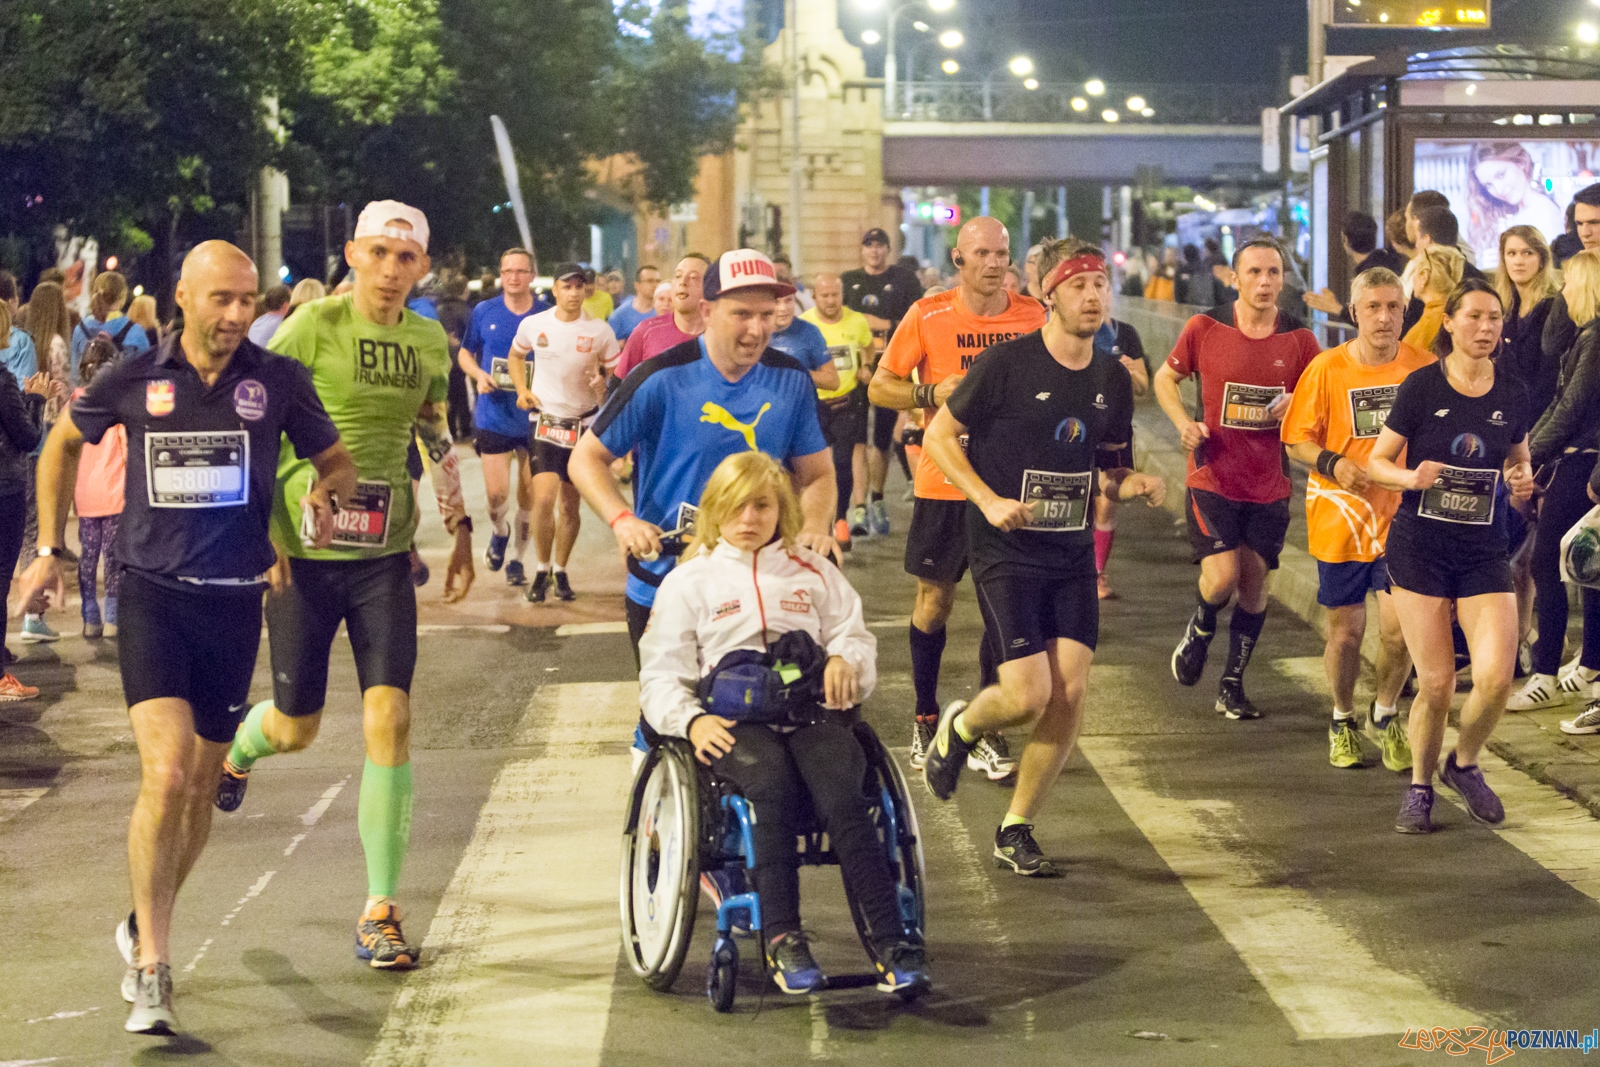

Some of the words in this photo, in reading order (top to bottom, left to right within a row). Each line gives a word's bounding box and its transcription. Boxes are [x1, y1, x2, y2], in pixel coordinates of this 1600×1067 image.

[359, 338, 417, 375] BTM
[359, 370, 417, 389] RUNNERS
[1035, 391, 1051, 401] 4F
[1434, 408, 1450, 417] 4F
[171, 468, 221, 490] 5800
[1043, 501, 1072, 518] 1571
[1440, 492, 1479, 512] 6022
